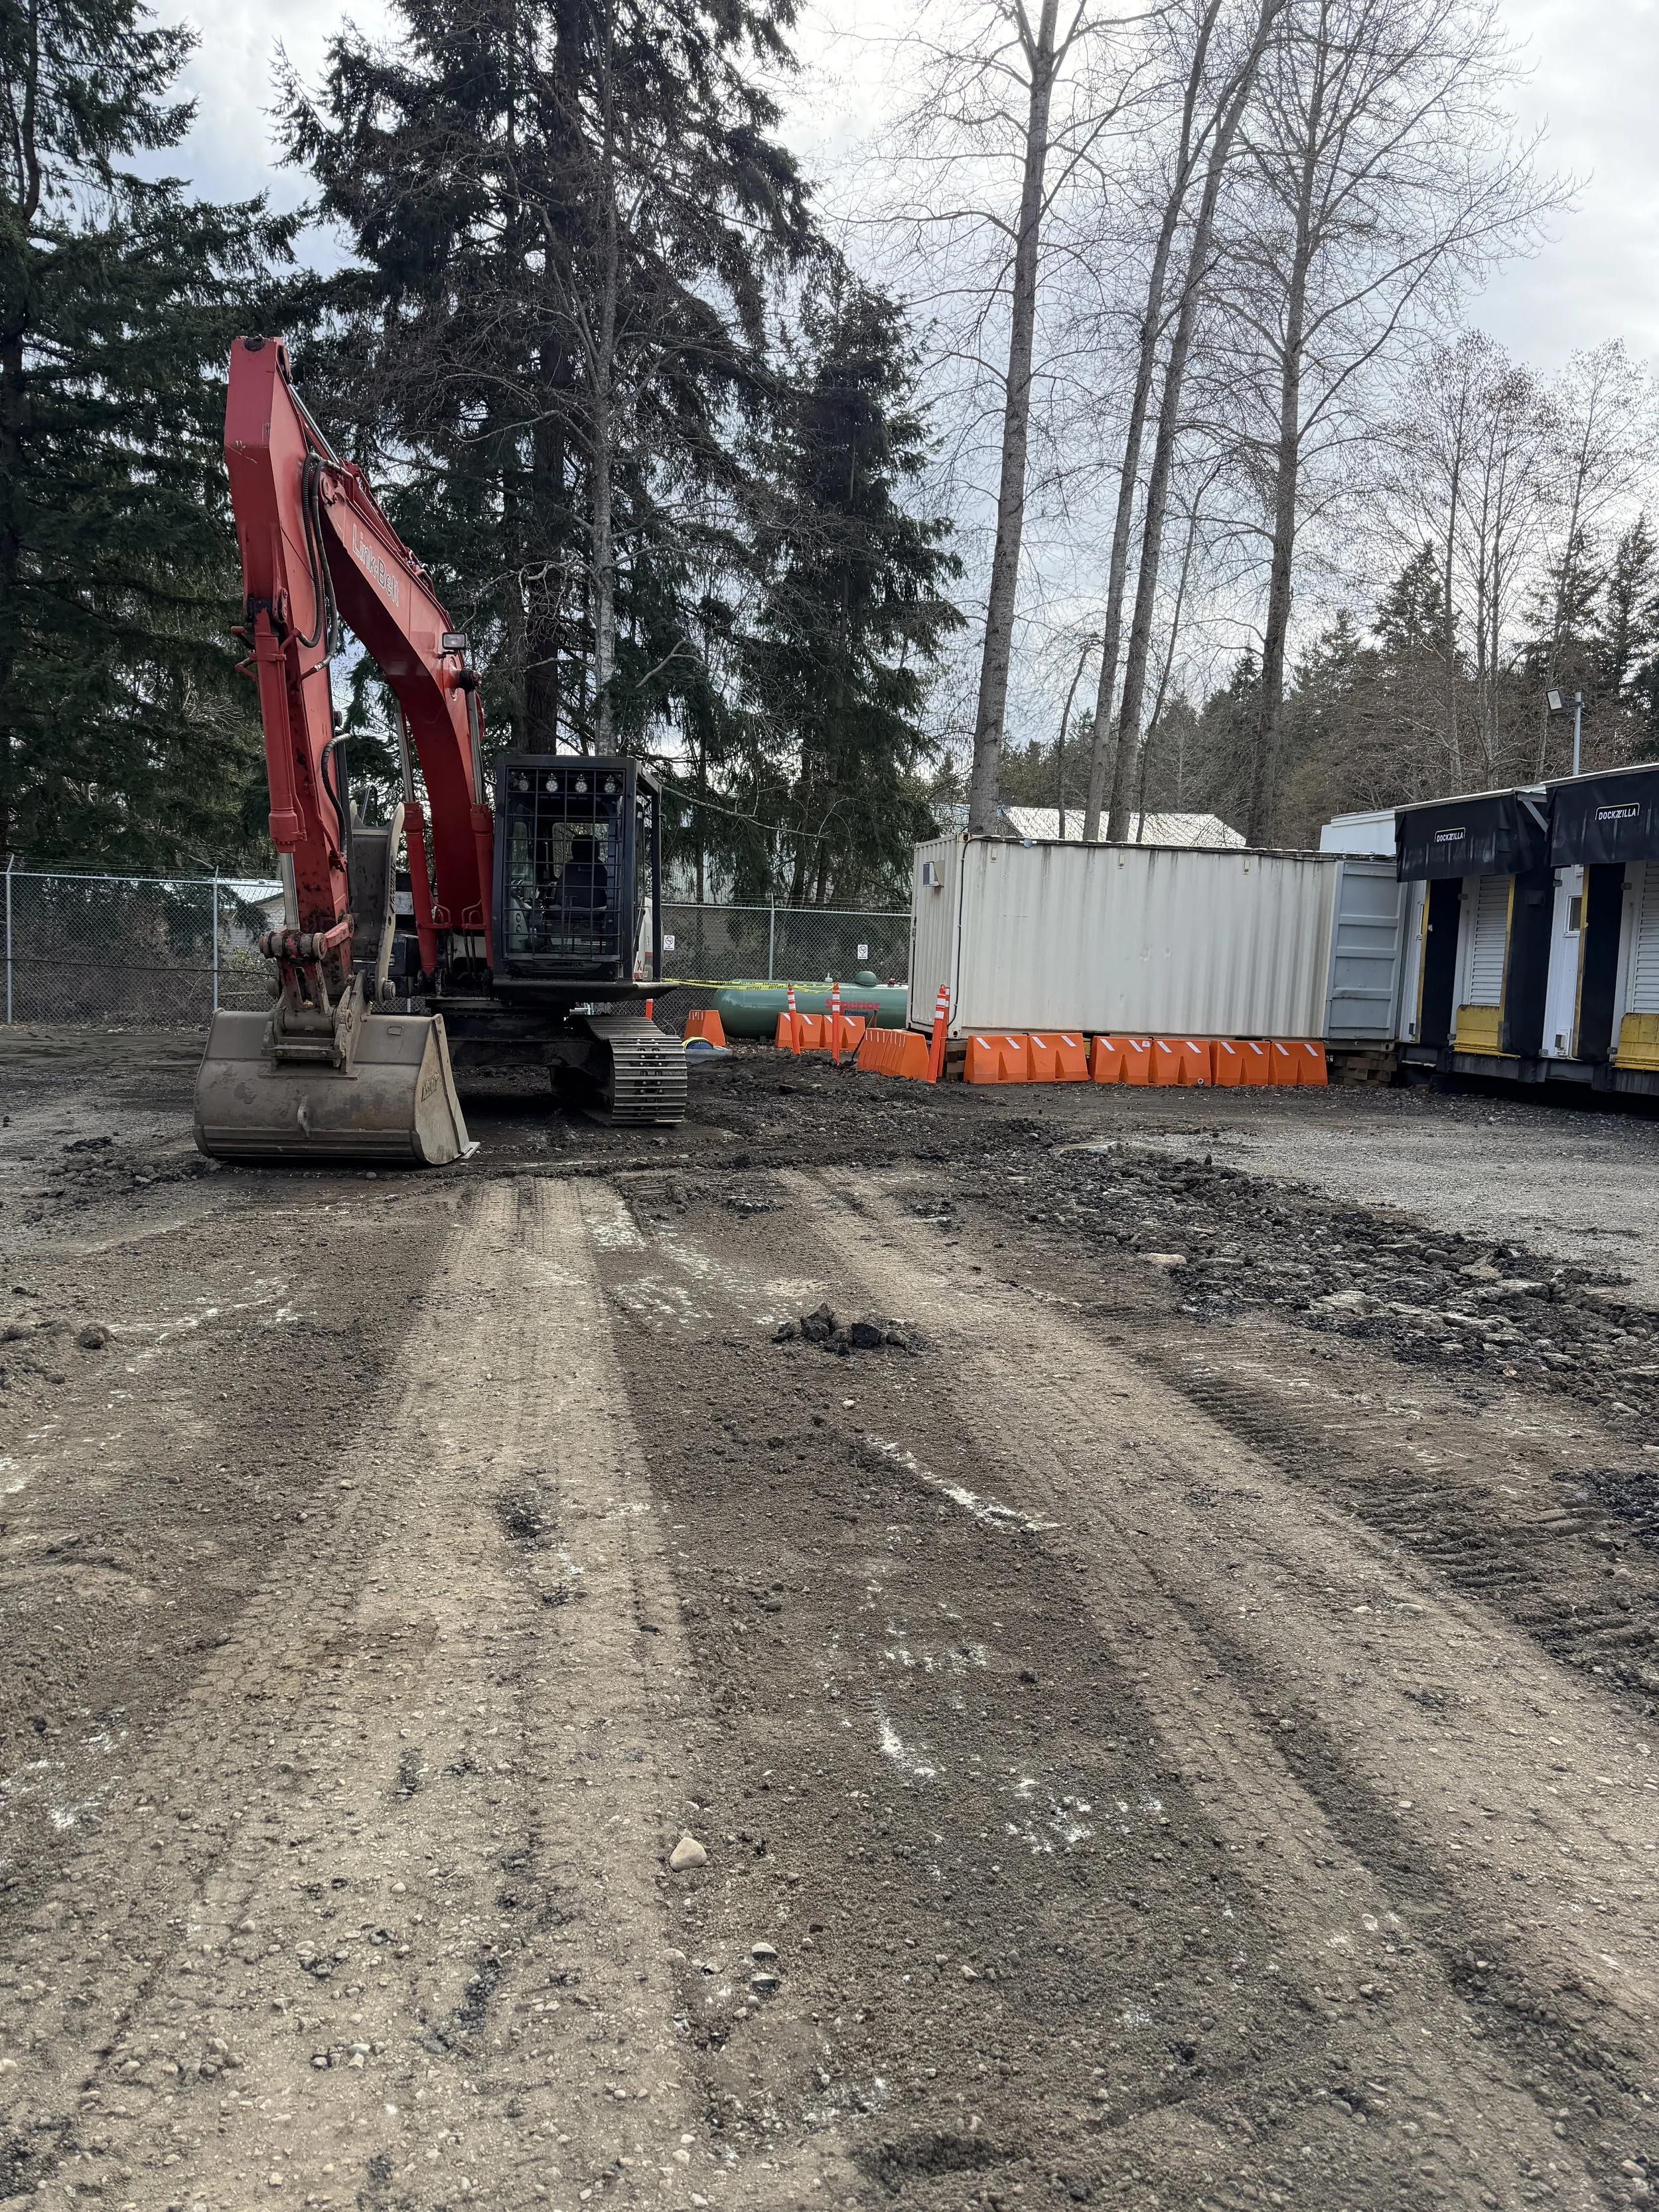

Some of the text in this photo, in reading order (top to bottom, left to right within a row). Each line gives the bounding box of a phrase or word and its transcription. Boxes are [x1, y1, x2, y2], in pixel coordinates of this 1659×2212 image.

[352, 523, 399, 607] Link-Belt
[1598, 808, 1636, 820] DOCKZILLA
[1436, 832, 1463, 842] DOCKZILLA
[824, 997, 881, 1014] Sperior
